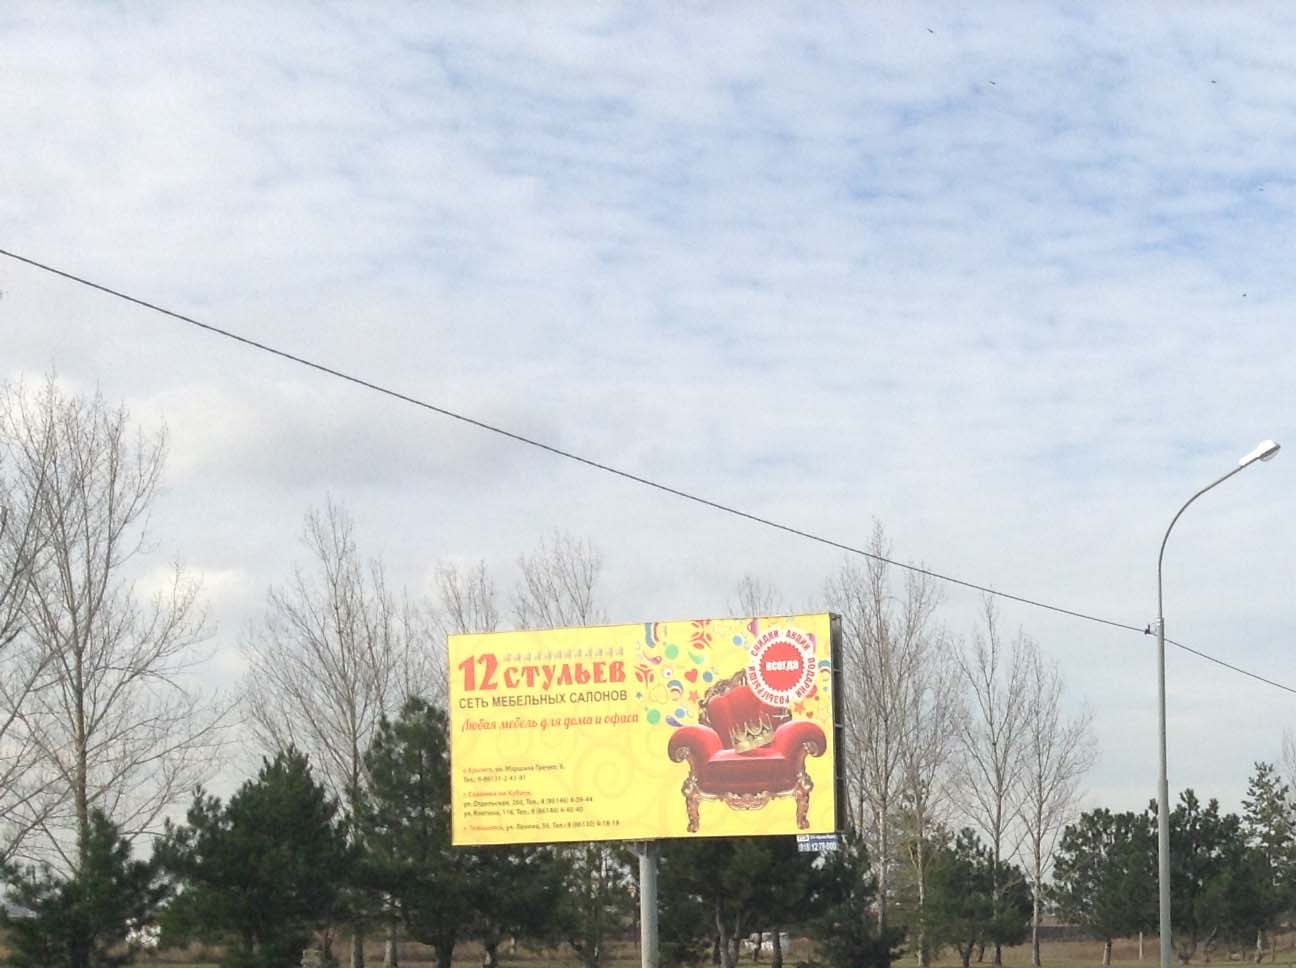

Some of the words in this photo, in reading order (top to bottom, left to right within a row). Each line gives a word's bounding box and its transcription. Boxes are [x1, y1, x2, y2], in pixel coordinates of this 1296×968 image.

[751, 630, 779, 657] СКИДКИ
[786, 630, 811, 651] АКЦИИ
[458, 653, 498, 692] 12
[503, 660, 626, 690] СТУЛЬЕВ
[765, 660, 800, 672] ВСЕГДА
[795, 657, 816, 698] ПОДАРКИ
[459, 697, 489, 710] СЕТЬ
[492, 692, 567, 707] МЕБЕЛЬНЫХ
[569, 689, 628, 704] САЛОНОВ
[461, 718, 497, 733] Любая
[499, 716, 538, 731] мебель
[540, 716, 562, 731] для
[564, 714, 593, 730] дома
[594, 715, 603, 725] и
[604, 713, 640, 729] офиса
